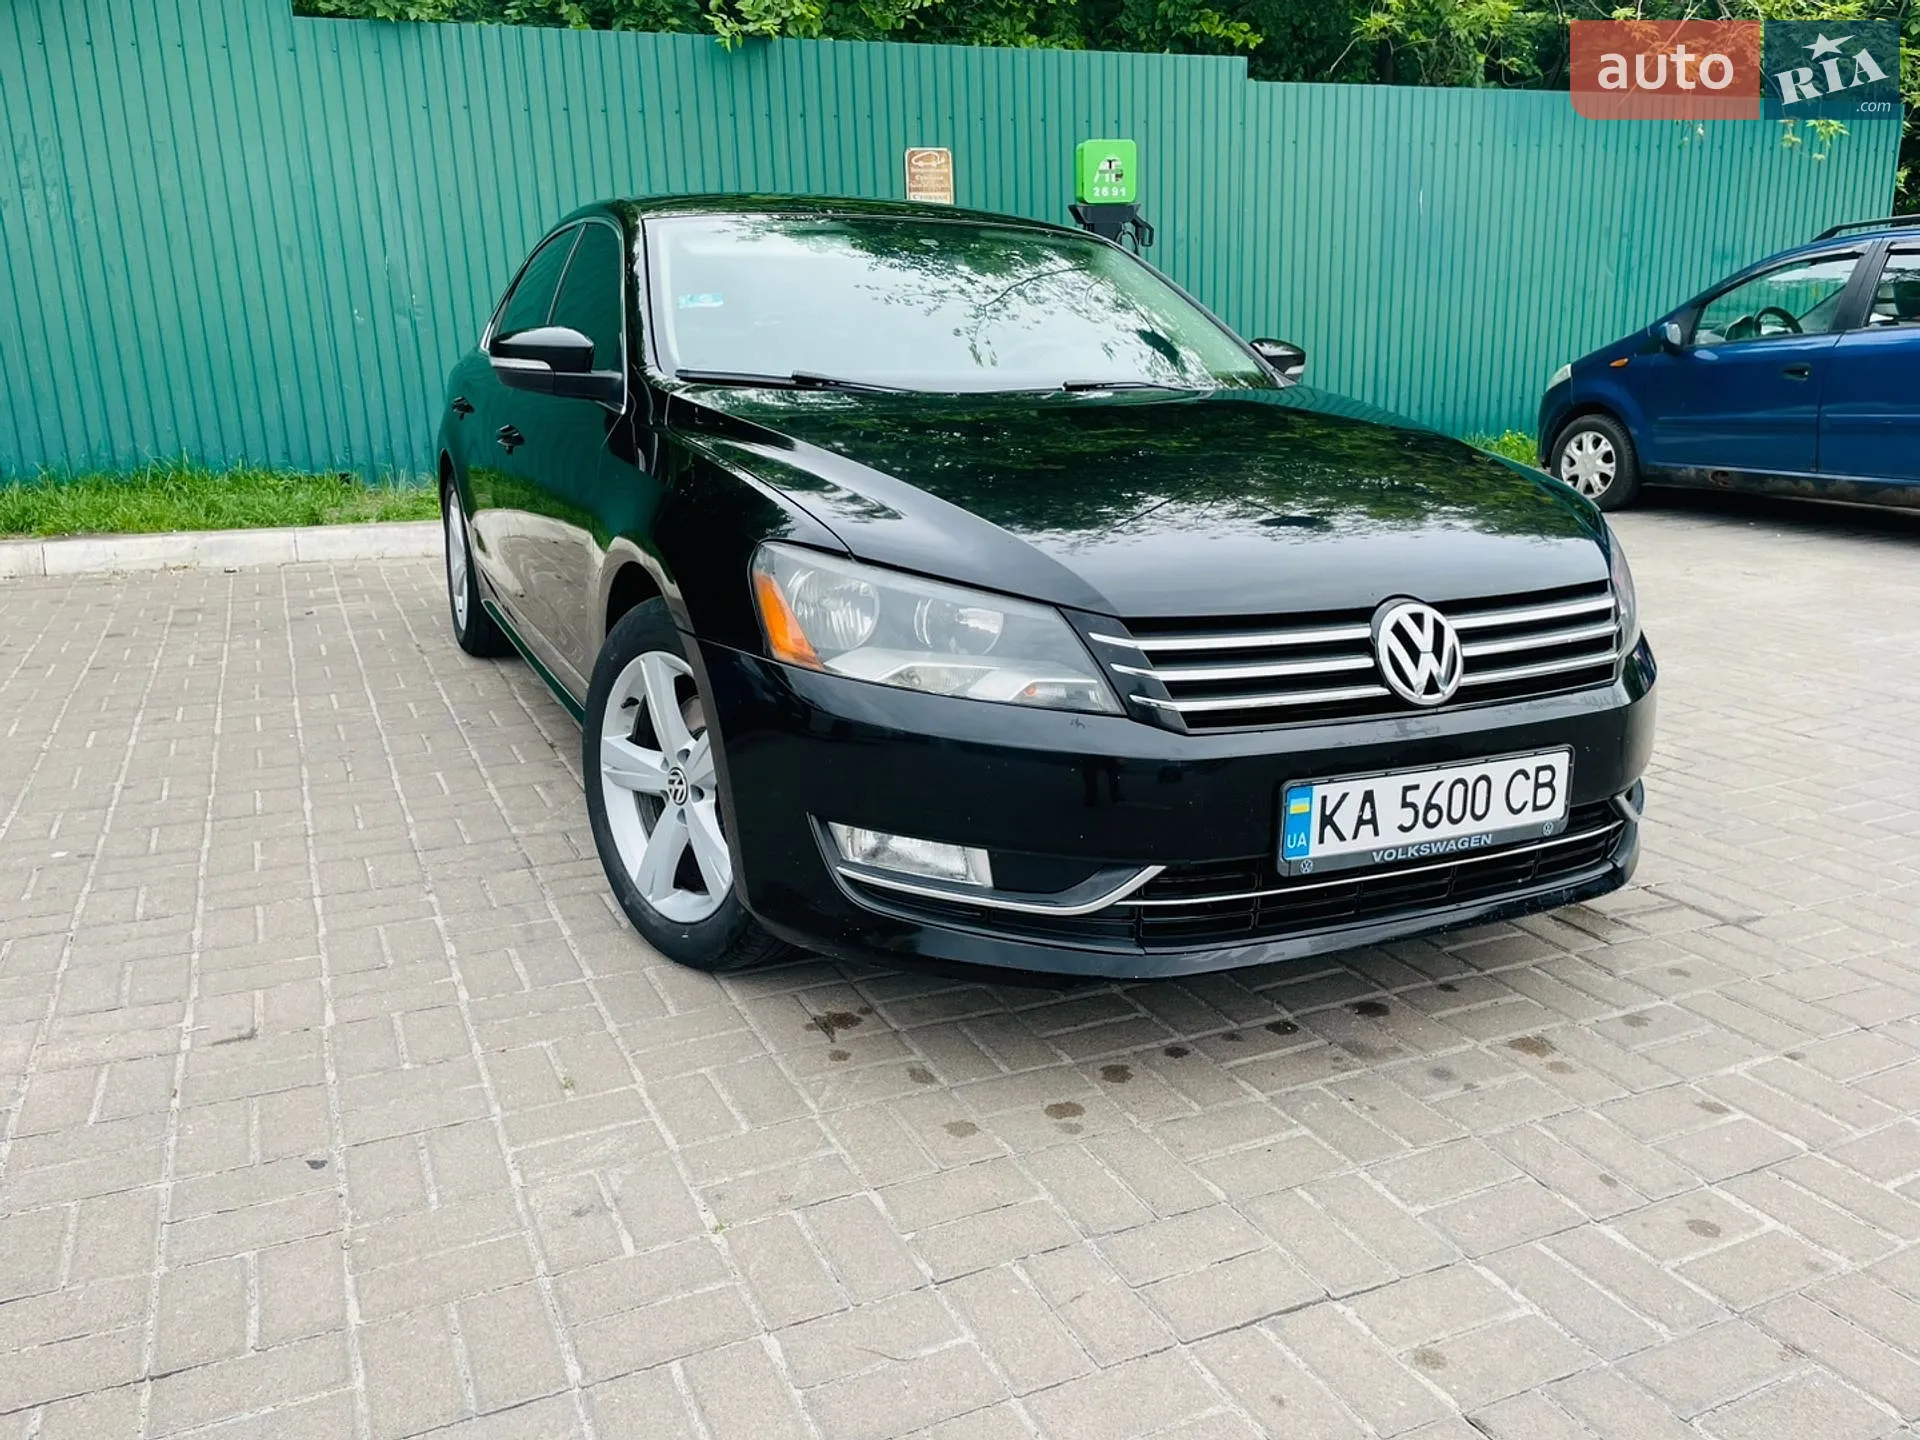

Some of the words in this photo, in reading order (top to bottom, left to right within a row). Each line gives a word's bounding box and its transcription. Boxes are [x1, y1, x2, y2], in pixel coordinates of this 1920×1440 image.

[1092, 186, 1126, 197] 2691
[1317, 789, 1380, 845] KA
[1396, 774, 1493, 833] 5600
[1504, 764, 1557, 815] CB
[1287, 832, 1307, 848] UA
[1372, 833, 1493, 863] VOLKSWAGEN
